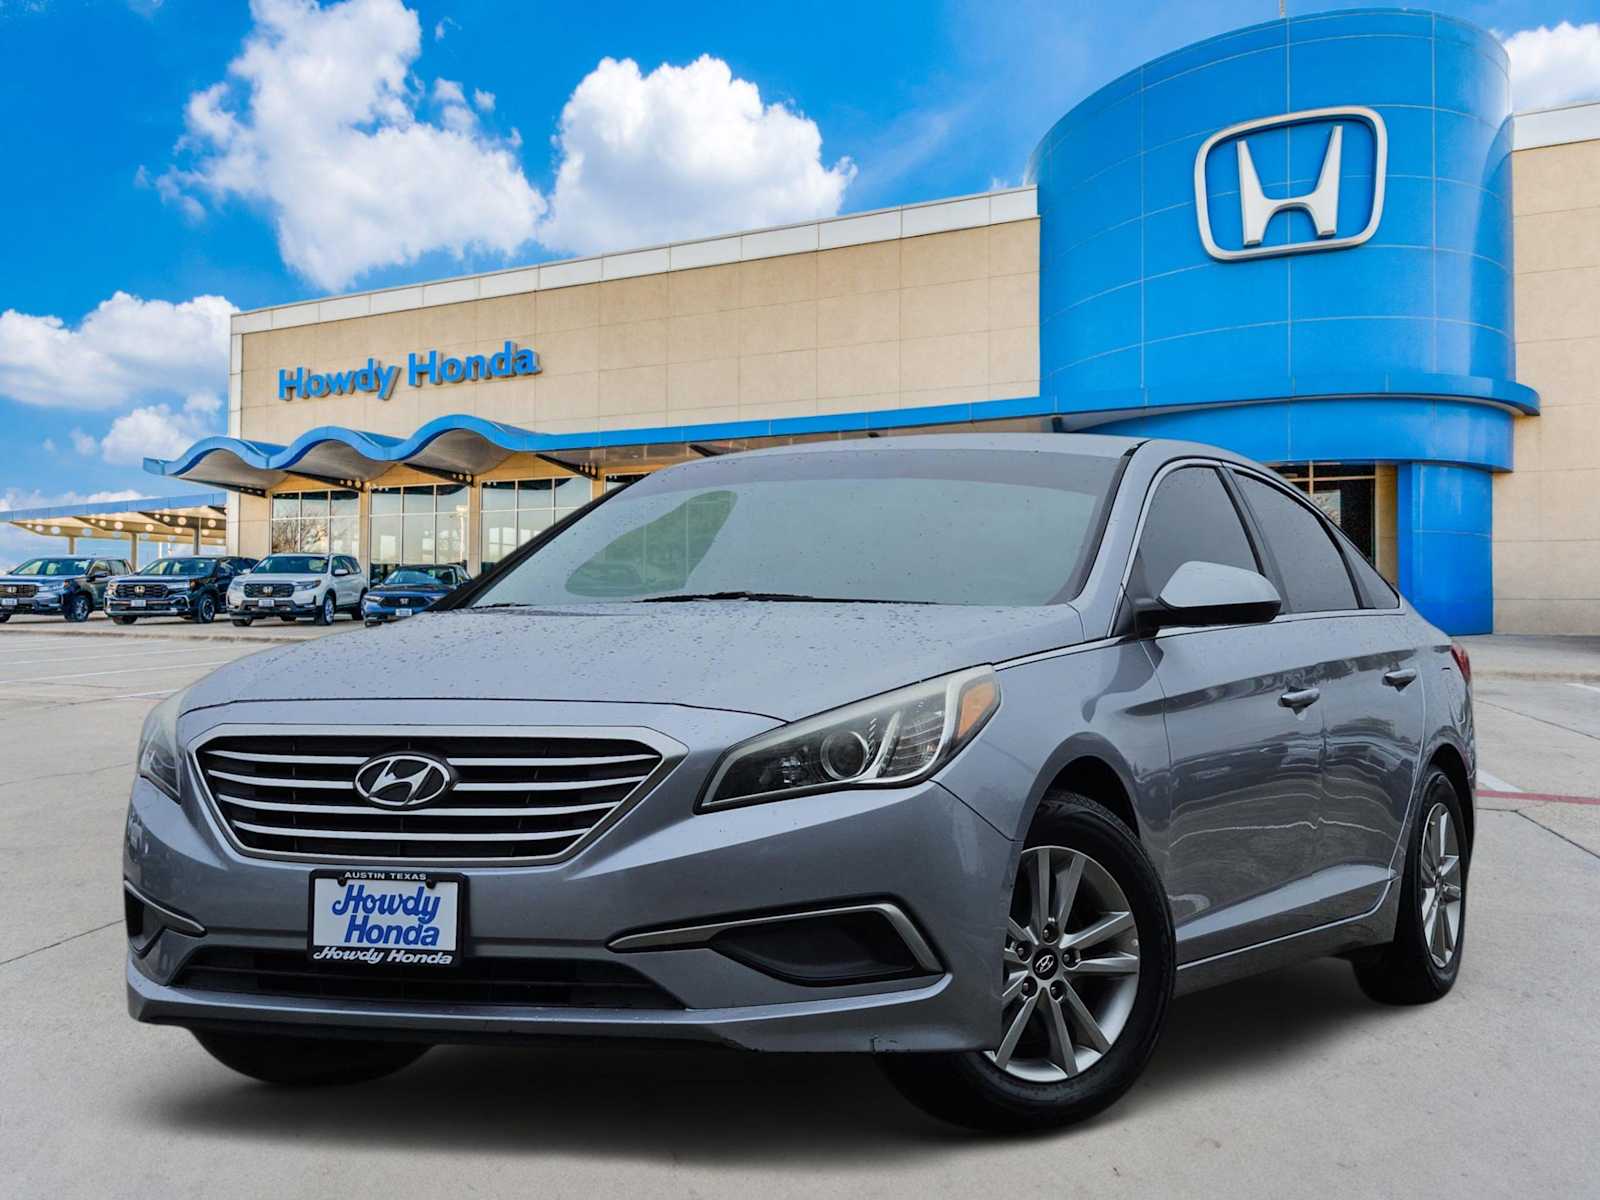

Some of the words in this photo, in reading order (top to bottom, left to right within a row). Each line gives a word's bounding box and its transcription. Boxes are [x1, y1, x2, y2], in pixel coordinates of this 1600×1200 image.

[279, 358, 401, 400] Howdy
[408, 341, 541, 387] Honda
[344, 871, 385, 880] AUSTIN
[390, 872, 427, 881] TEXAS
[332, 884, 441, 924] Howdy
[344, 914, 440, 946] Honda
[313, 946, 385, 964] Howdy
[386, 949, 453, 965] Honda
